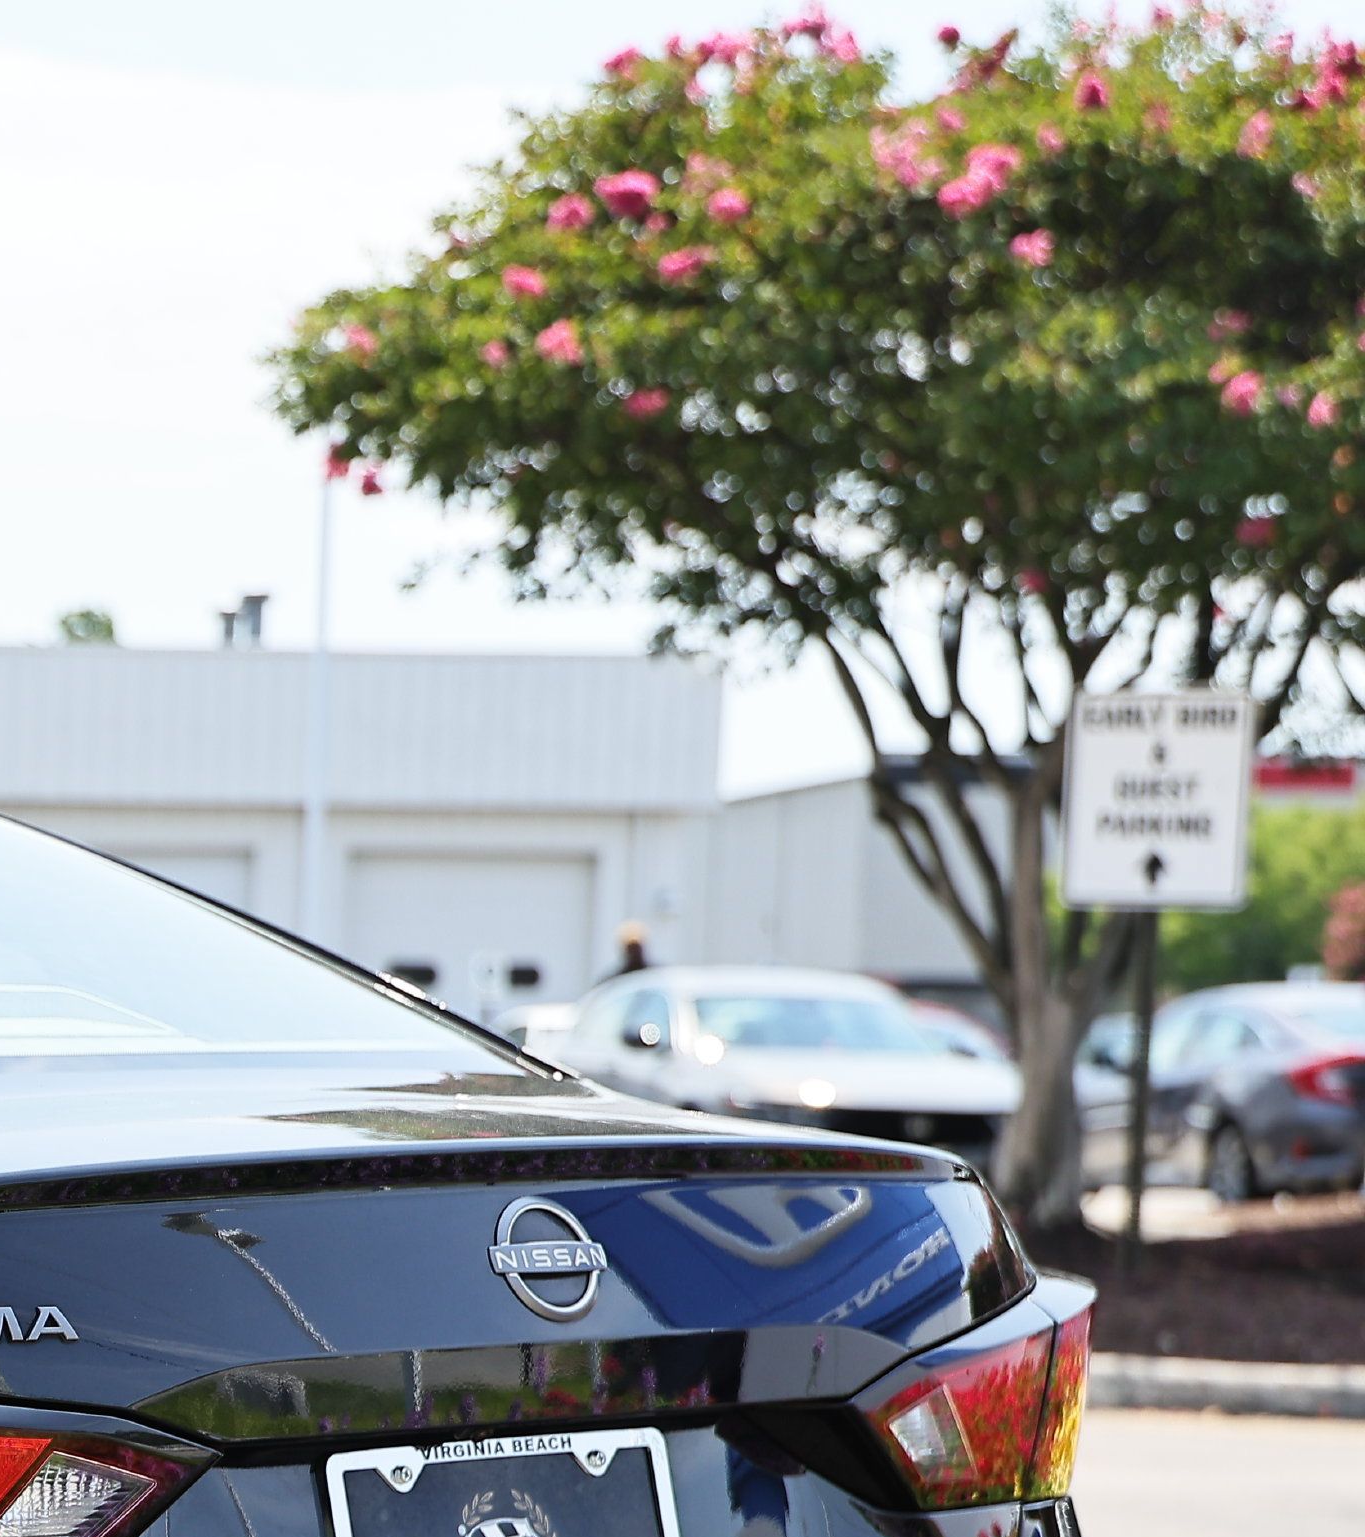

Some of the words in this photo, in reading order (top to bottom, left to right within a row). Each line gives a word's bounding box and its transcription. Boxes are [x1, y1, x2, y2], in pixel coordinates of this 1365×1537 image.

[495, 1247, 607, 1269] NISSAN
[420, 1440, 505, 1461] VIRGINIA
[512, 1434, 572, 1453] BEACH
